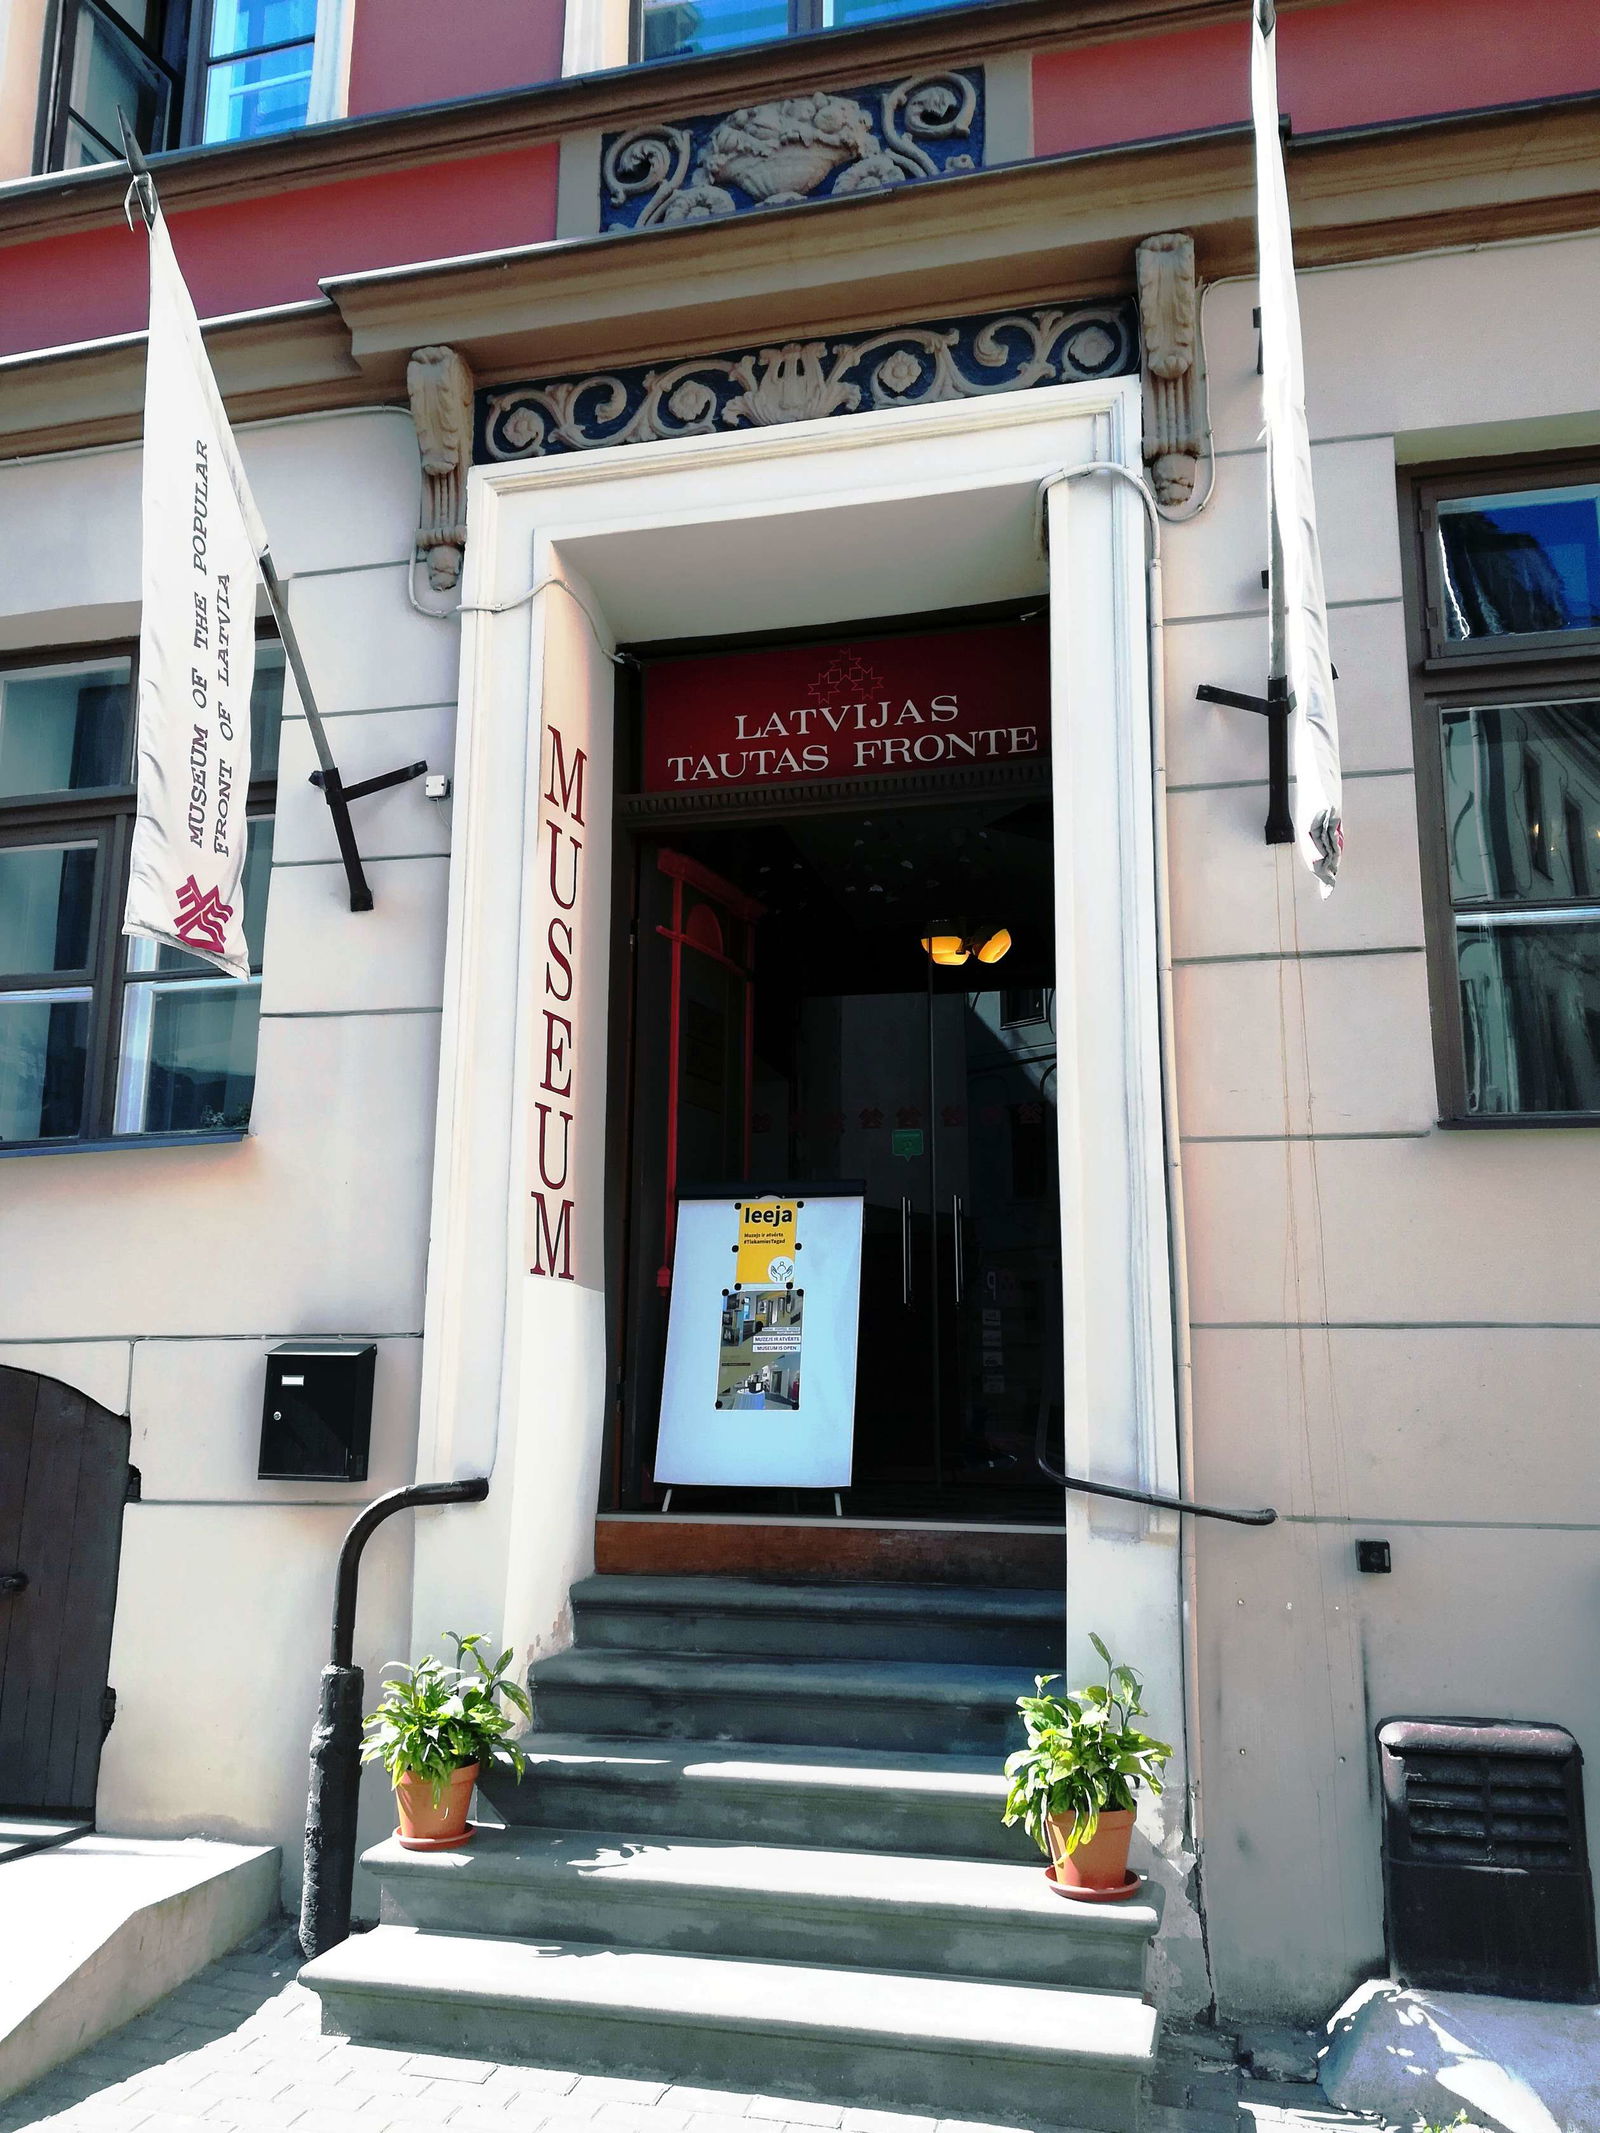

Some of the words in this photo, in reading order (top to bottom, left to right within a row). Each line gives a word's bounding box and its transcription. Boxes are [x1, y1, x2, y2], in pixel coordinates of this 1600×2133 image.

[192, 439, 208, 576] POPULAR
[193, 591, 209, 650] THE
[216, 574, 231, 687] LATVIA
[192, 667, 208, 709] OF
[217, 701, 234, 742] OF
[734, 694, 959, 741] LATVIJAS
[188, 723, 209, 849] MUSEUM
[667, 744, 829, 783] TAUTAS
[852, 725, 1039, 767] FRONTE
[213, 758, 232, 858] FRONT
[530, 723, 588, 1281] MUSEUM
